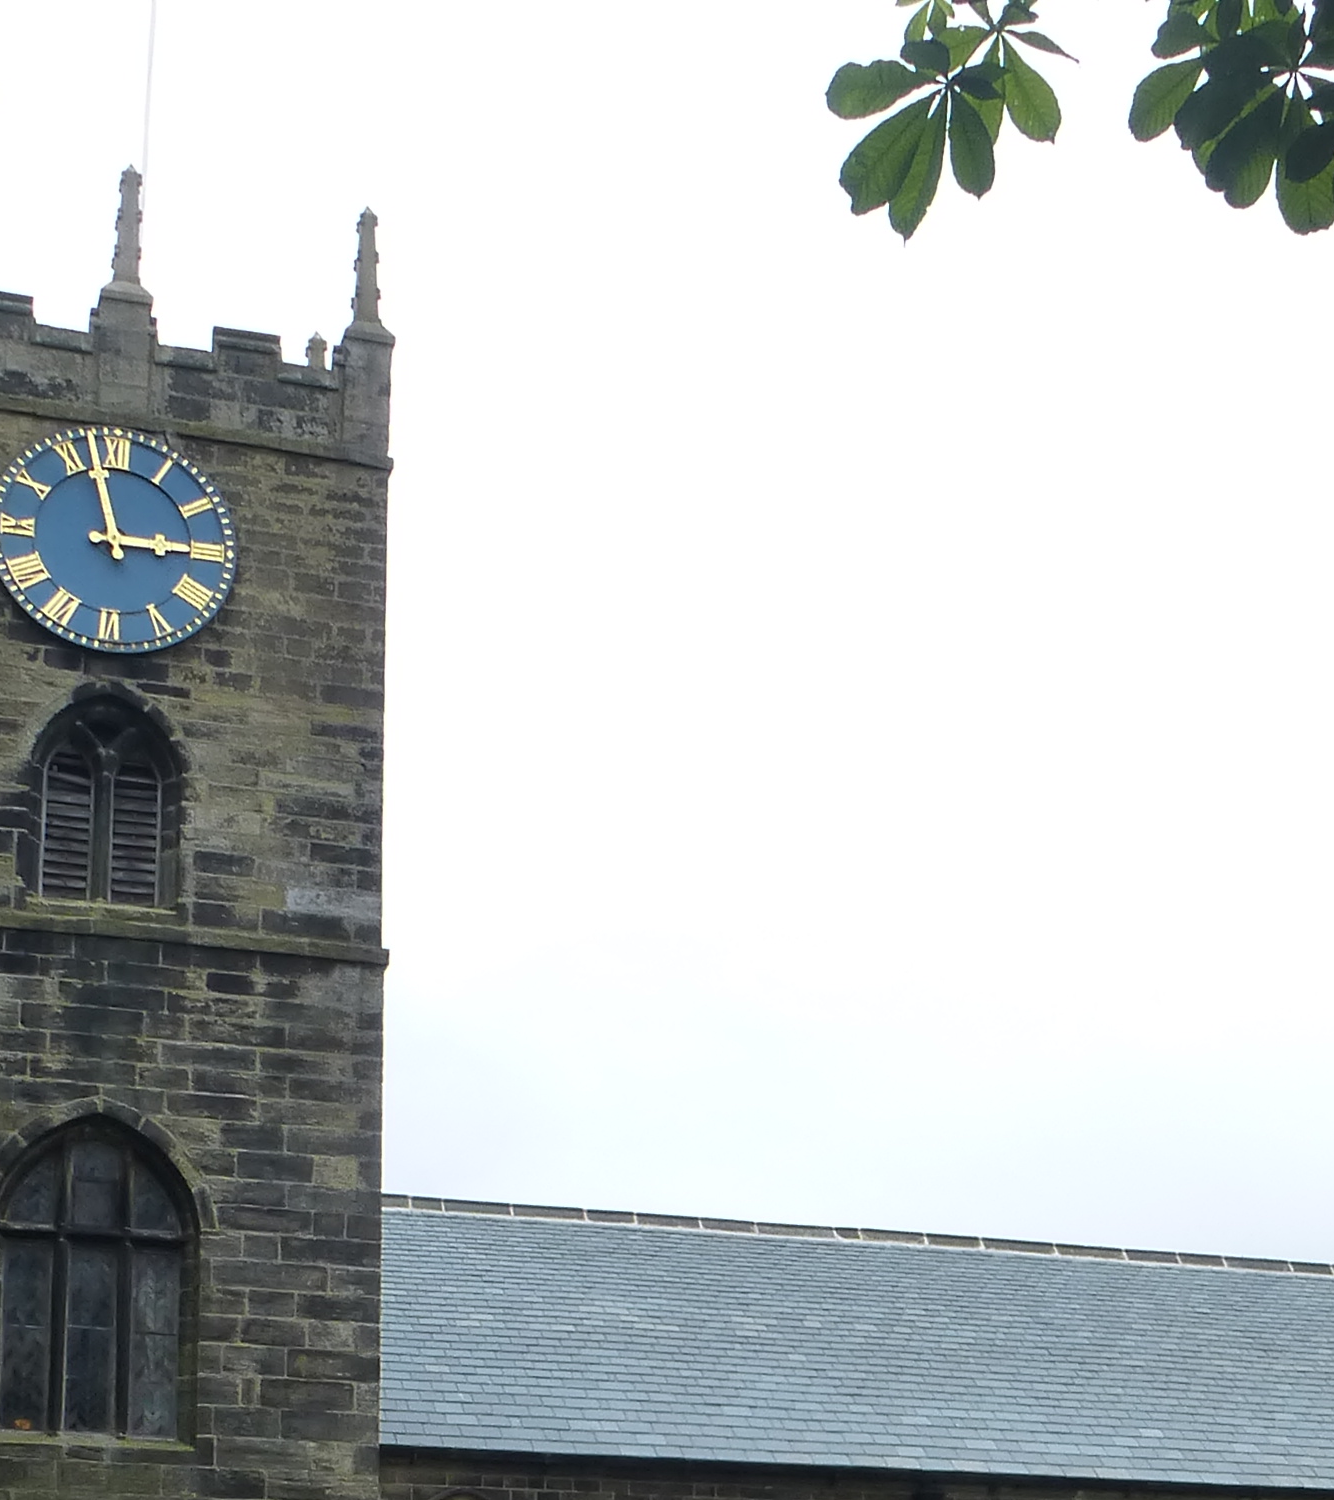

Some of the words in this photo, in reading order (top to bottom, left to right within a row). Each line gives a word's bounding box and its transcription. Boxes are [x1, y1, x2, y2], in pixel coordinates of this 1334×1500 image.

[53, 440, 88, 476] XI
[103, 436, 132, 471] XII
[15, 468, 52, 500] X
[152, 457, 176, 485] I
[0, 512, 35, 537] IX
[179, 496, 214, 519] II
[190, 540, 225, 563] III
[6, 551, 51, 590] VIII
[40, 586, 83, 627] VII
[172, 573, 214, 611] IIII
[98, 607, 121, 641] VI
[146, 603, 174, 637] V
